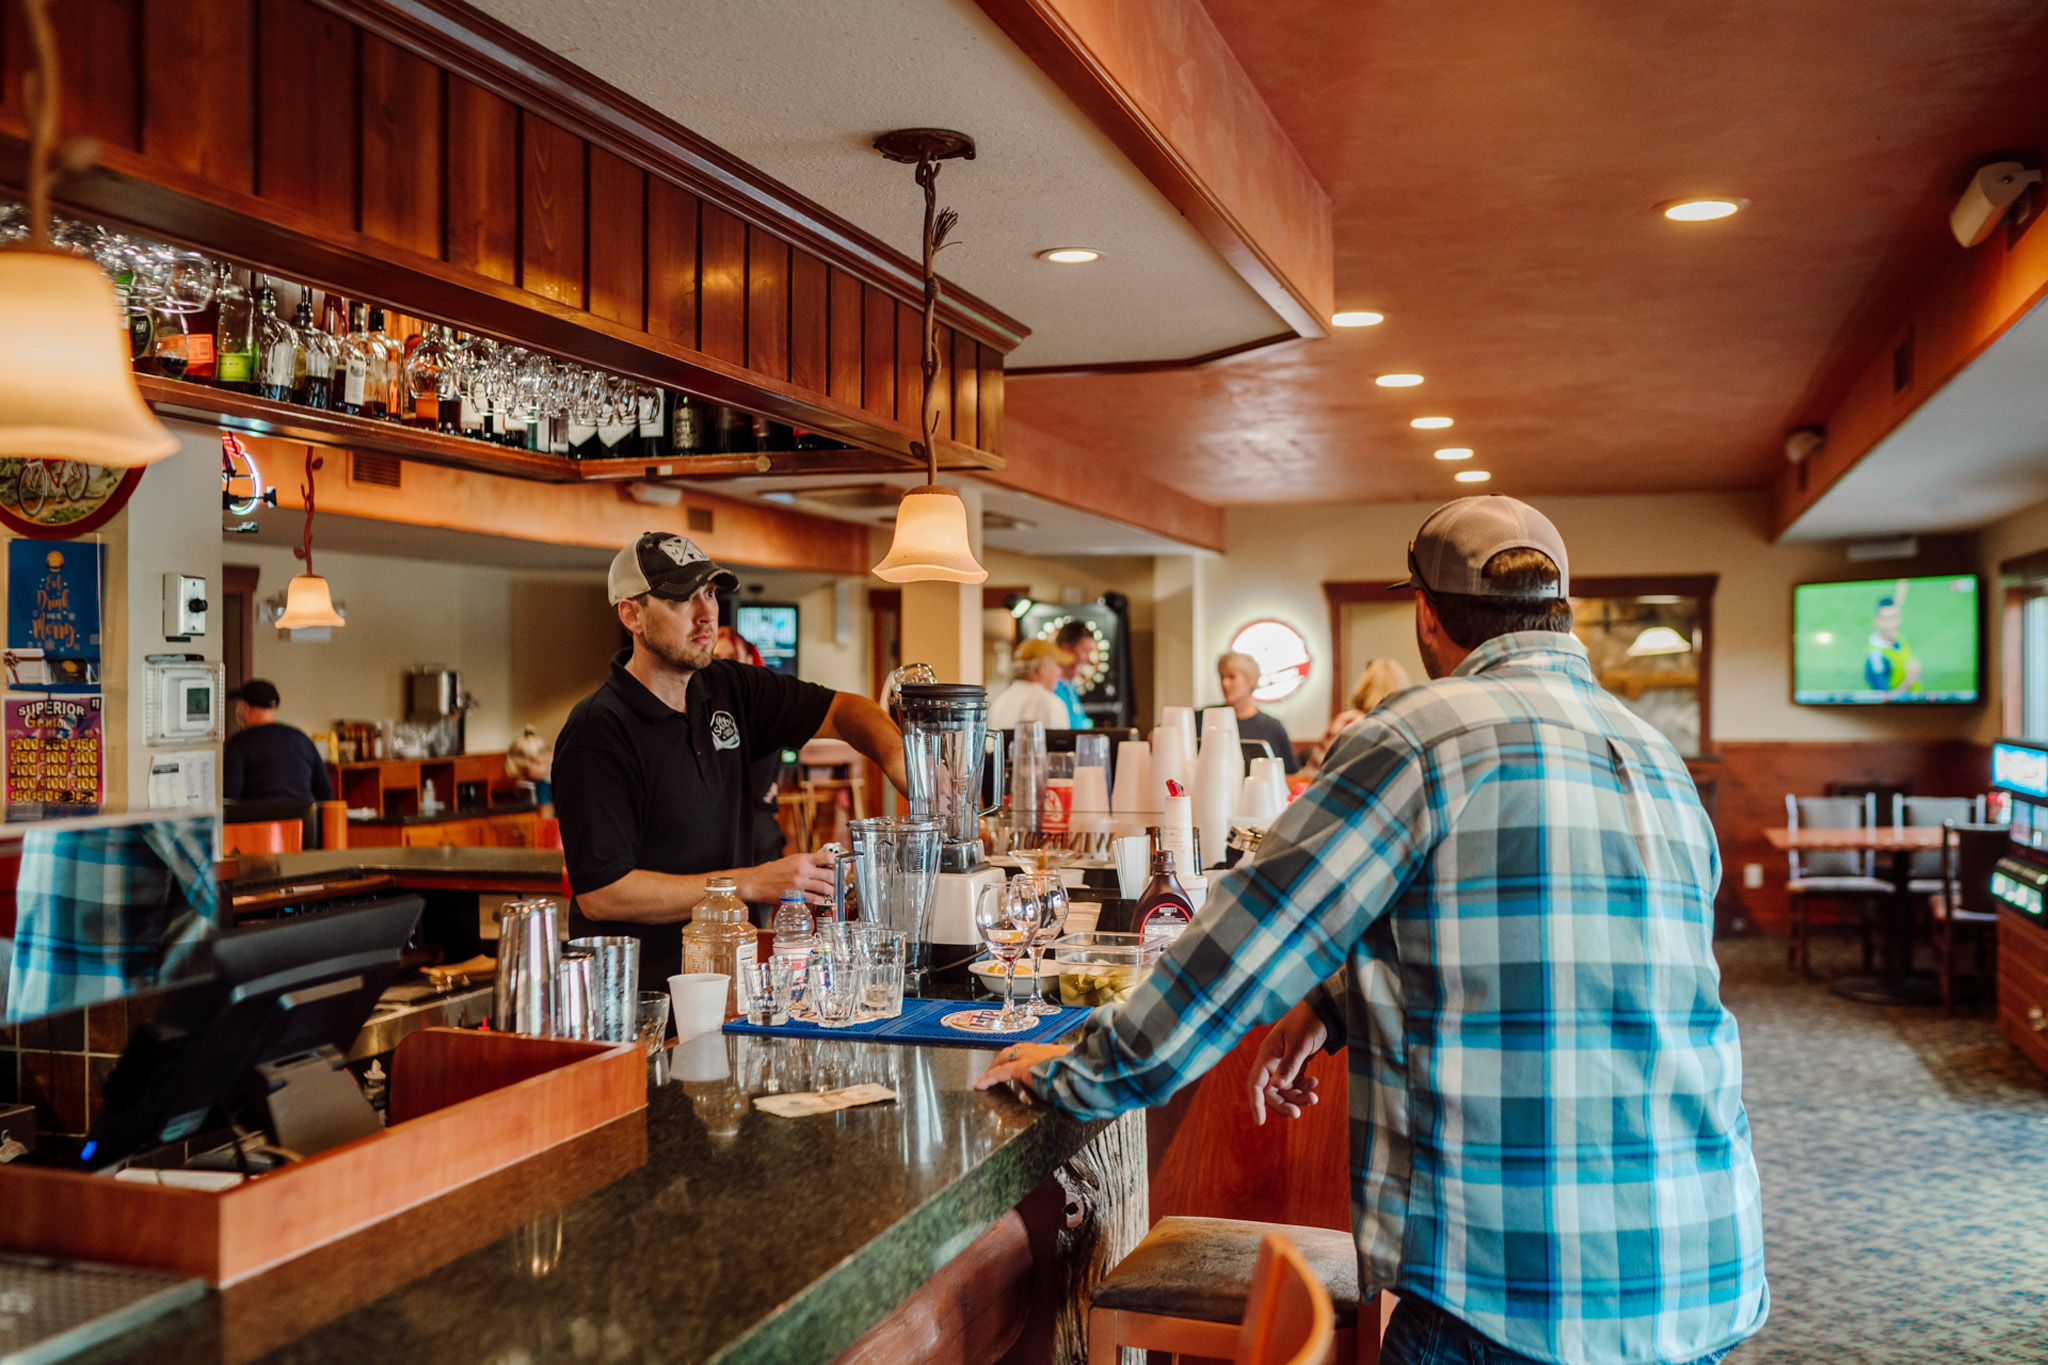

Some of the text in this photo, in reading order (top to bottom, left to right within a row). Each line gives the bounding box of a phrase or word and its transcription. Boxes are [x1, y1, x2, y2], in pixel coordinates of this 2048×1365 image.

[18, 701, 85, 715] SUPERIOR
[70, 751, 97, 764] $100
[10, 764, 97, 777] $100 $100 $100
[10, 777, 97, 790] $100 $100 $100
